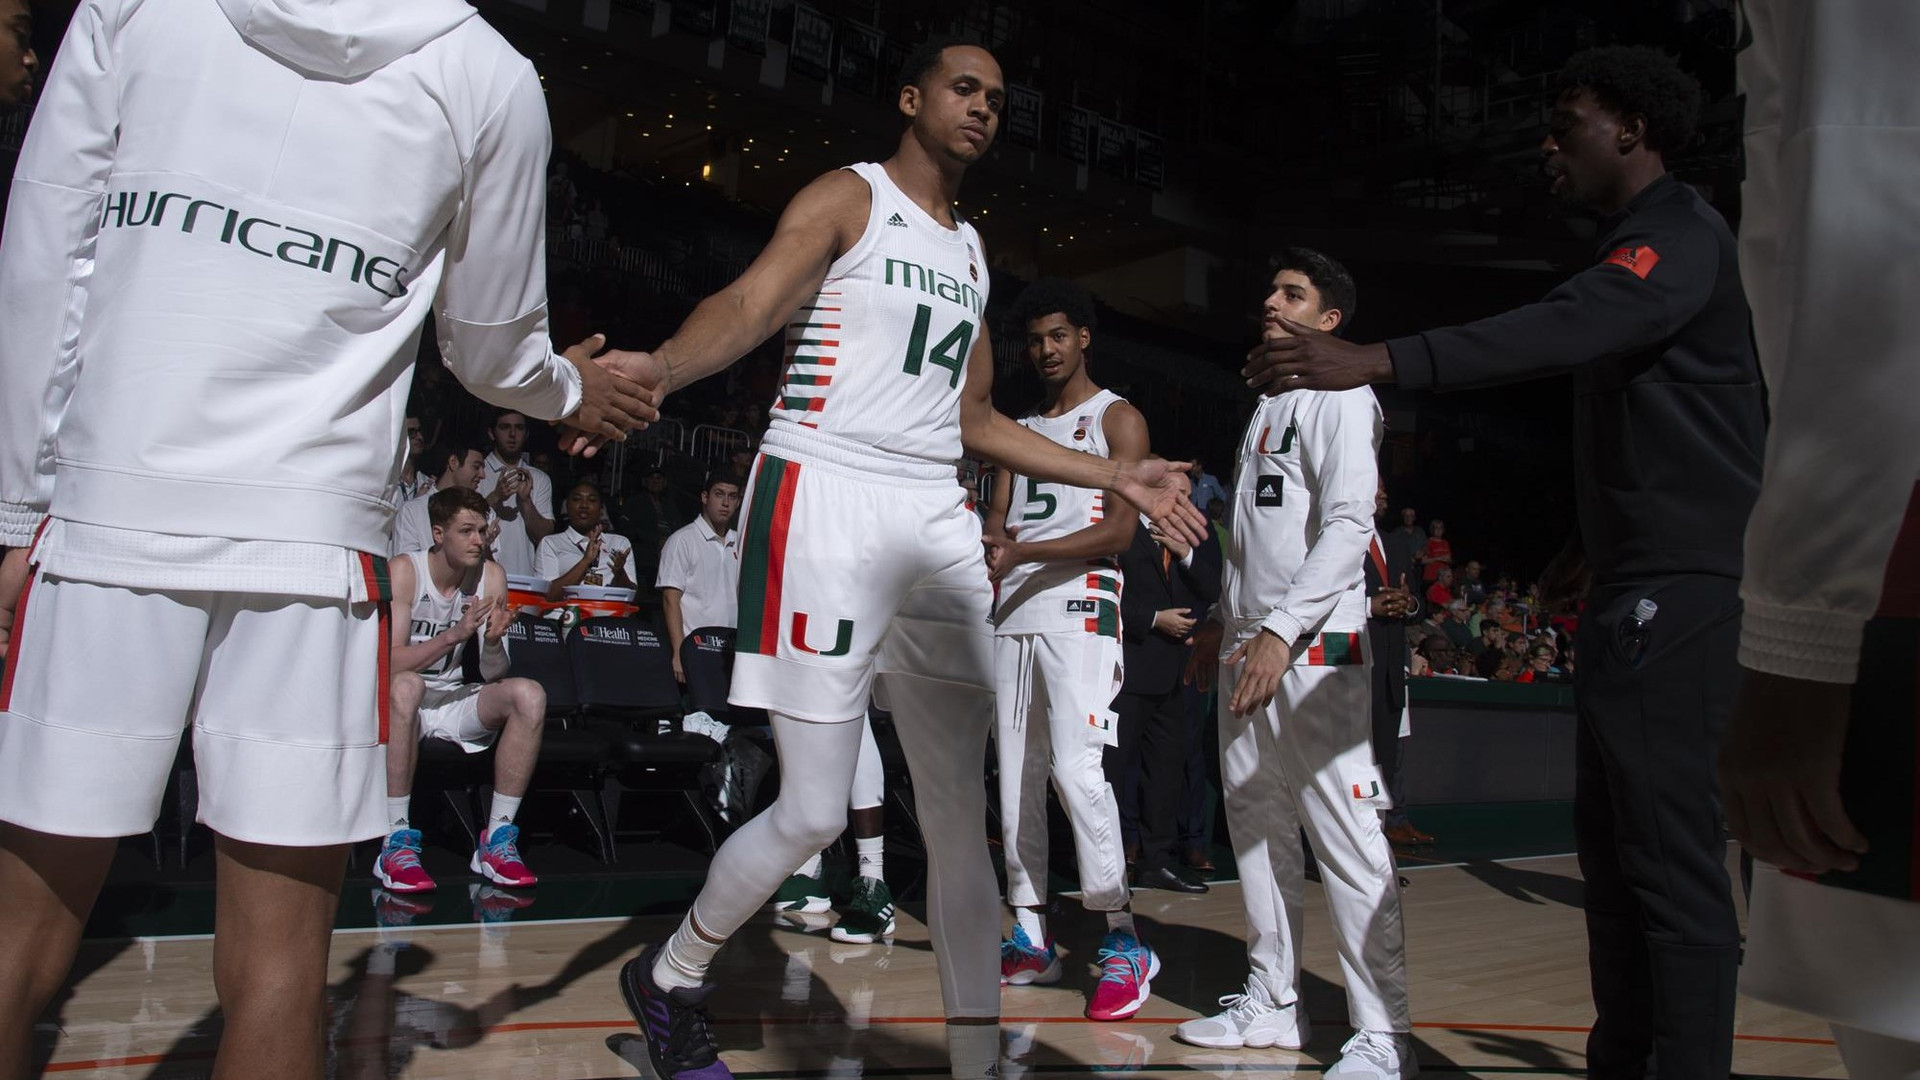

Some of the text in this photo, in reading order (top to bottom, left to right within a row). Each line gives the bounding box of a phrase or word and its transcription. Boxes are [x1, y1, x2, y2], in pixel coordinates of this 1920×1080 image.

[903, 303, 974, 390] 14
[1023, 476, 1058, 521] 5
[791, 611, 855, 657] U
